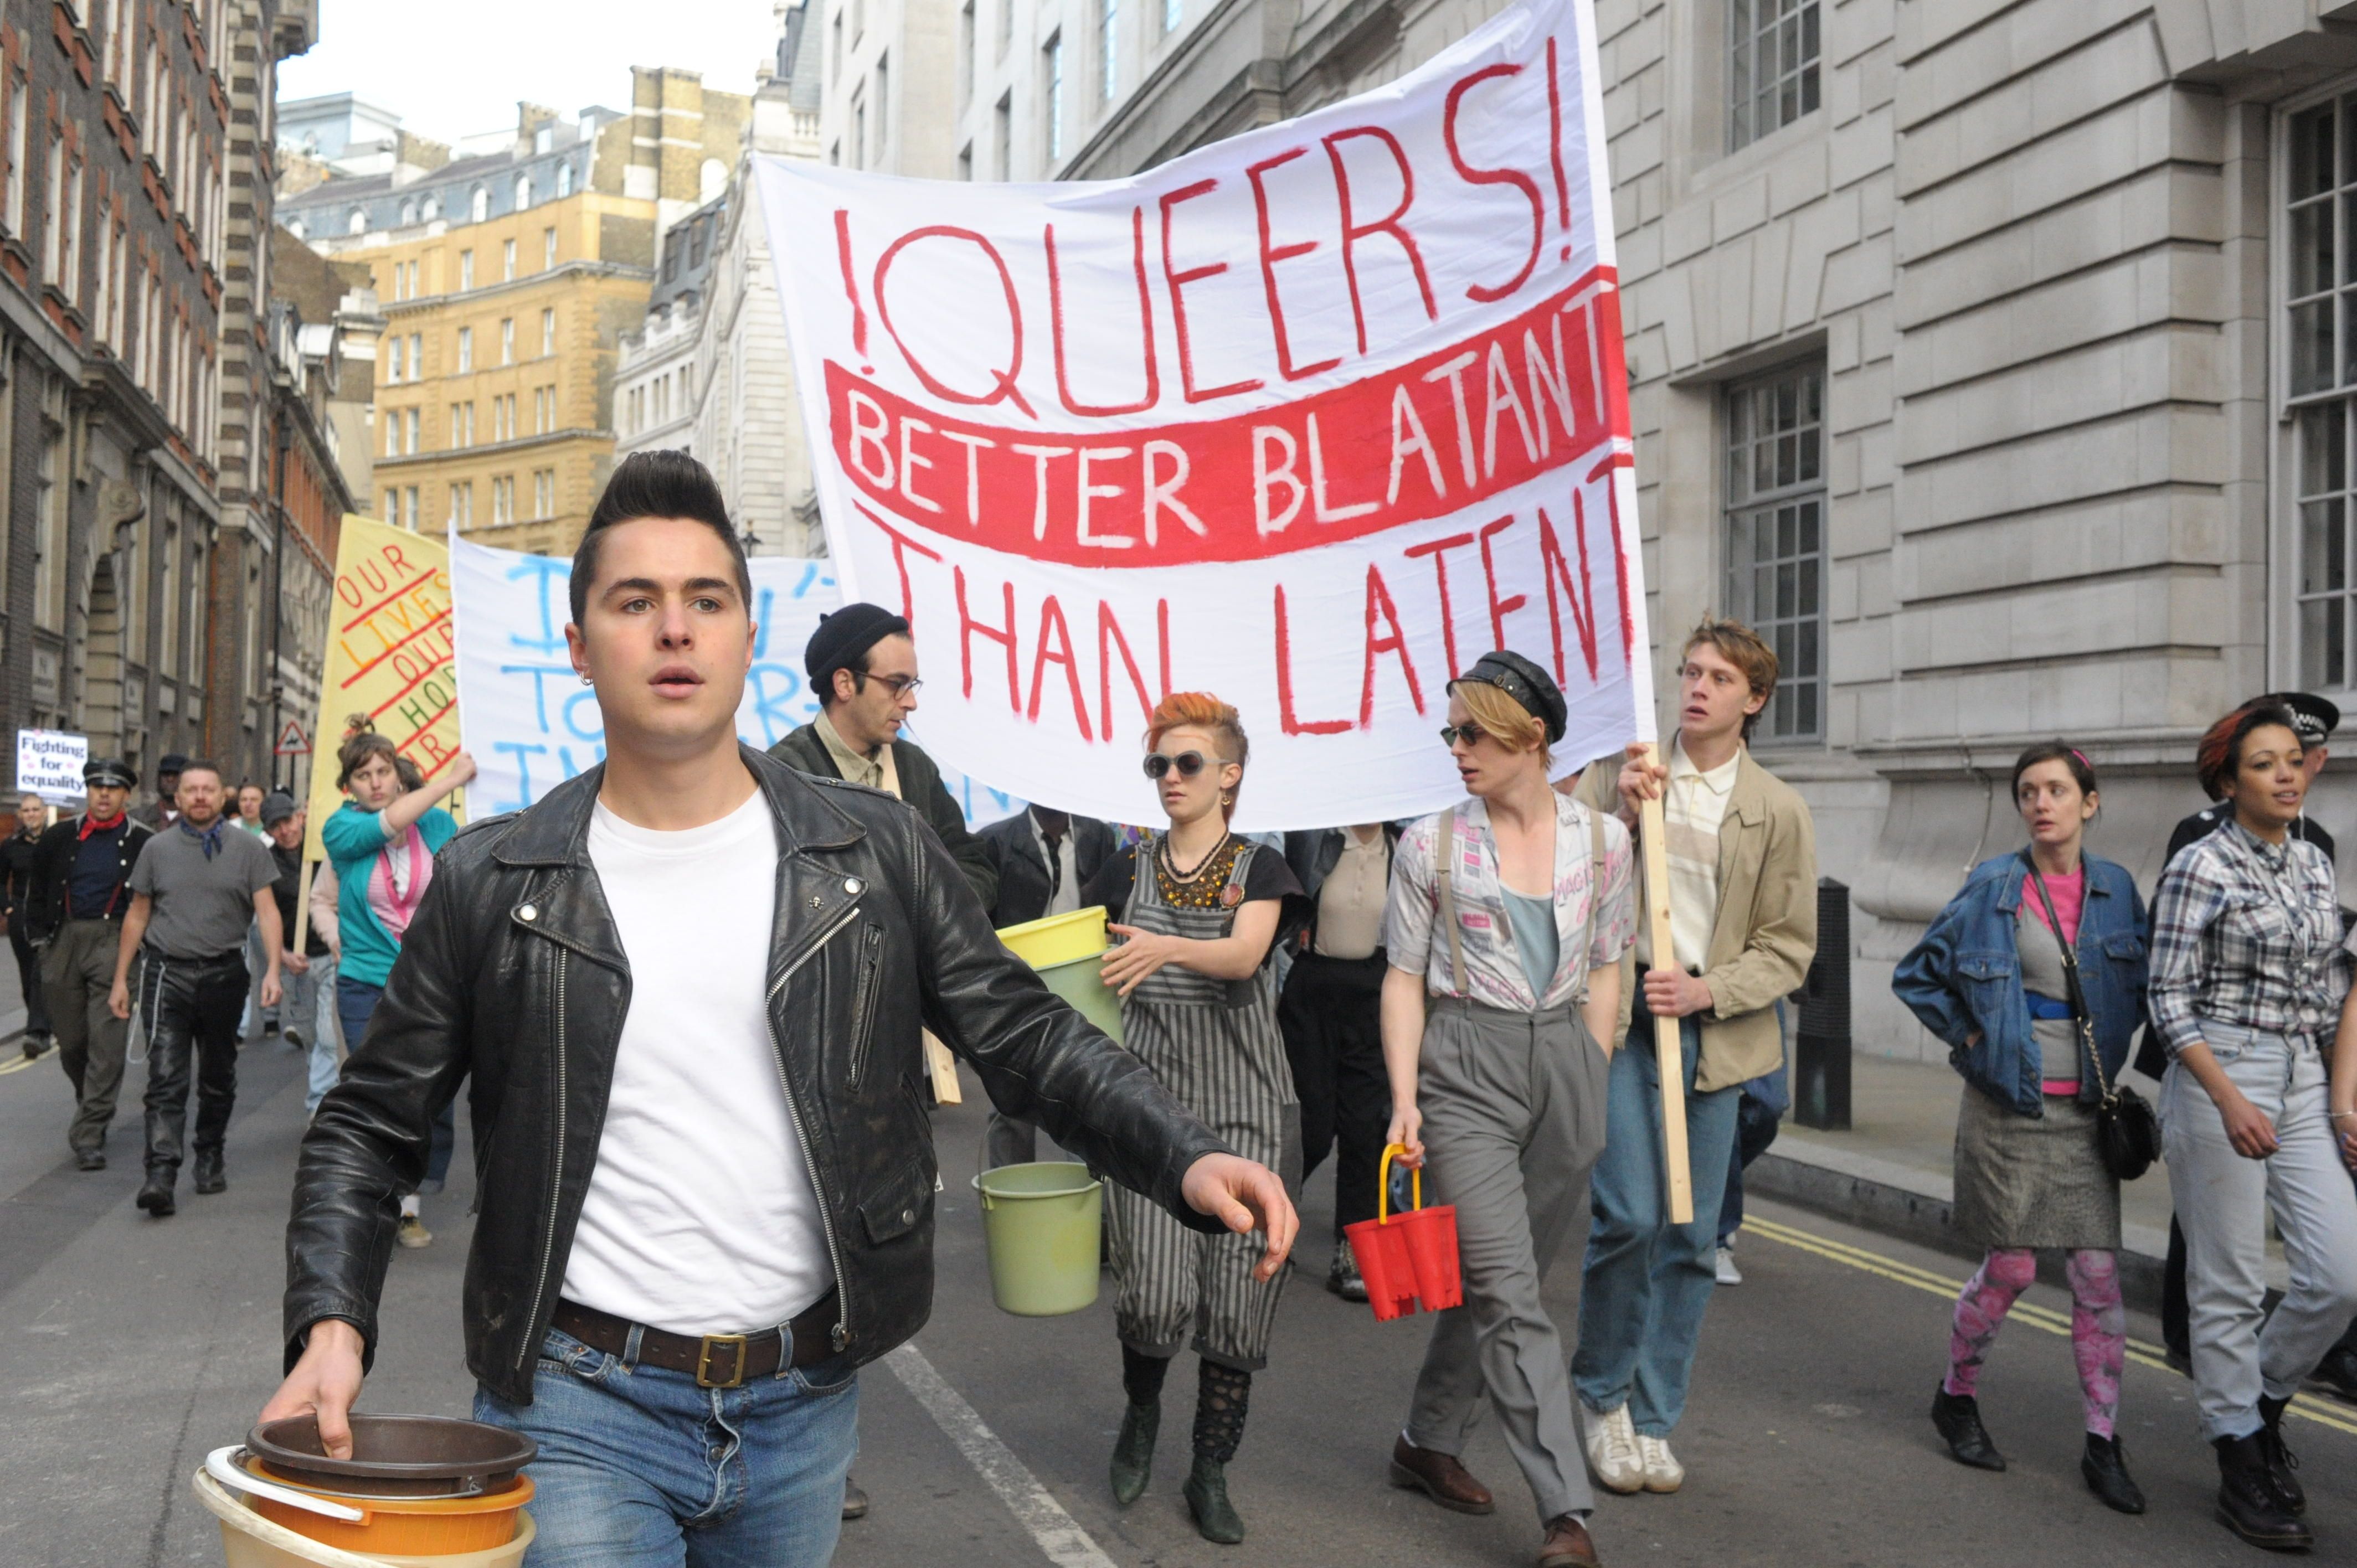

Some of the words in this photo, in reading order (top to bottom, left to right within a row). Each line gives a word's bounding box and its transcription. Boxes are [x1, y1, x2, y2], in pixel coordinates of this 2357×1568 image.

[847, 389, 1207, 549] BETTER
[1253, 280, 1615, 537] BLATANT
[336, 544, 416, 609] OUR
[852, 498, 1170, 743] THAN
[1275, 453, 1634, 735] LATENT
[21, 737, 84, 758] Fighting
[40, 756, 64, 771] for
[21, 775, 85, 792] equality
